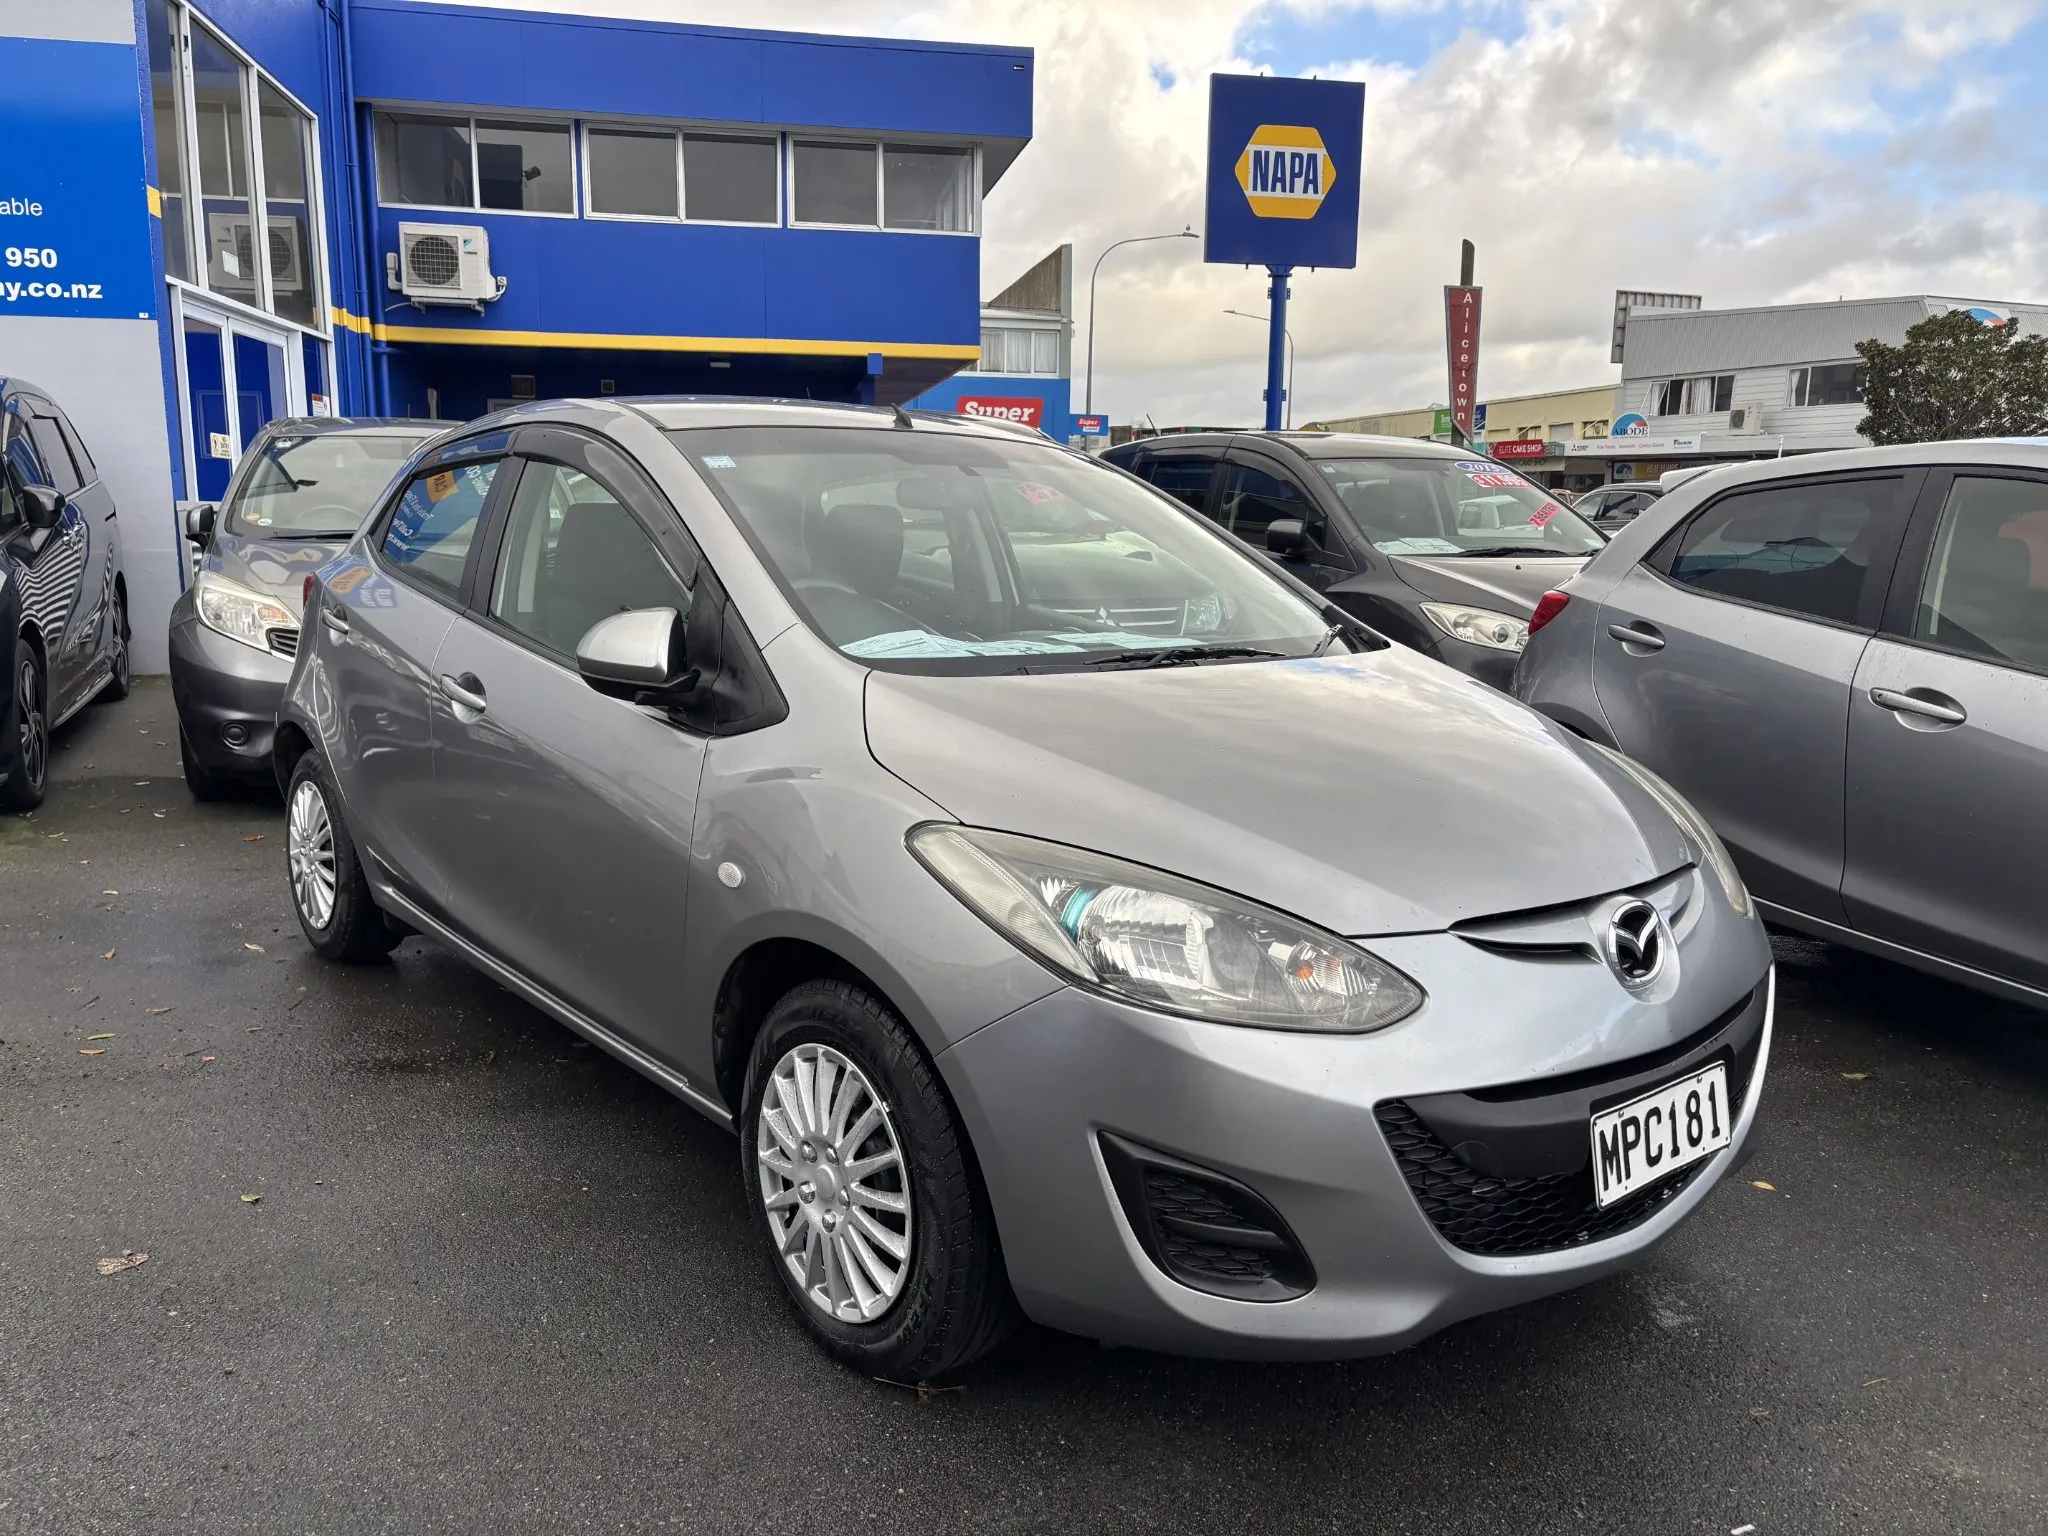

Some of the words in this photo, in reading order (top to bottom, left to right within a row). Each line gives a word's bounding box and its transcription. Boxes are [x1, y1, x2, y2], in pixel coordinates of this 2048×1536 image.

[1252, 150, 1319, 195] NAPA
[5, 247, 58, 268] 950
[1078, 418, 1099, 426] Super
[1612, 427, 1649, 436] ABODE
[1498, 446, 1512, 454] ELITE
[1512, 445, 1527, 453] CAKE
[1527, 444, 1542, 453] SHOP
[1598, 1080, 1721, 1192] MPC181
